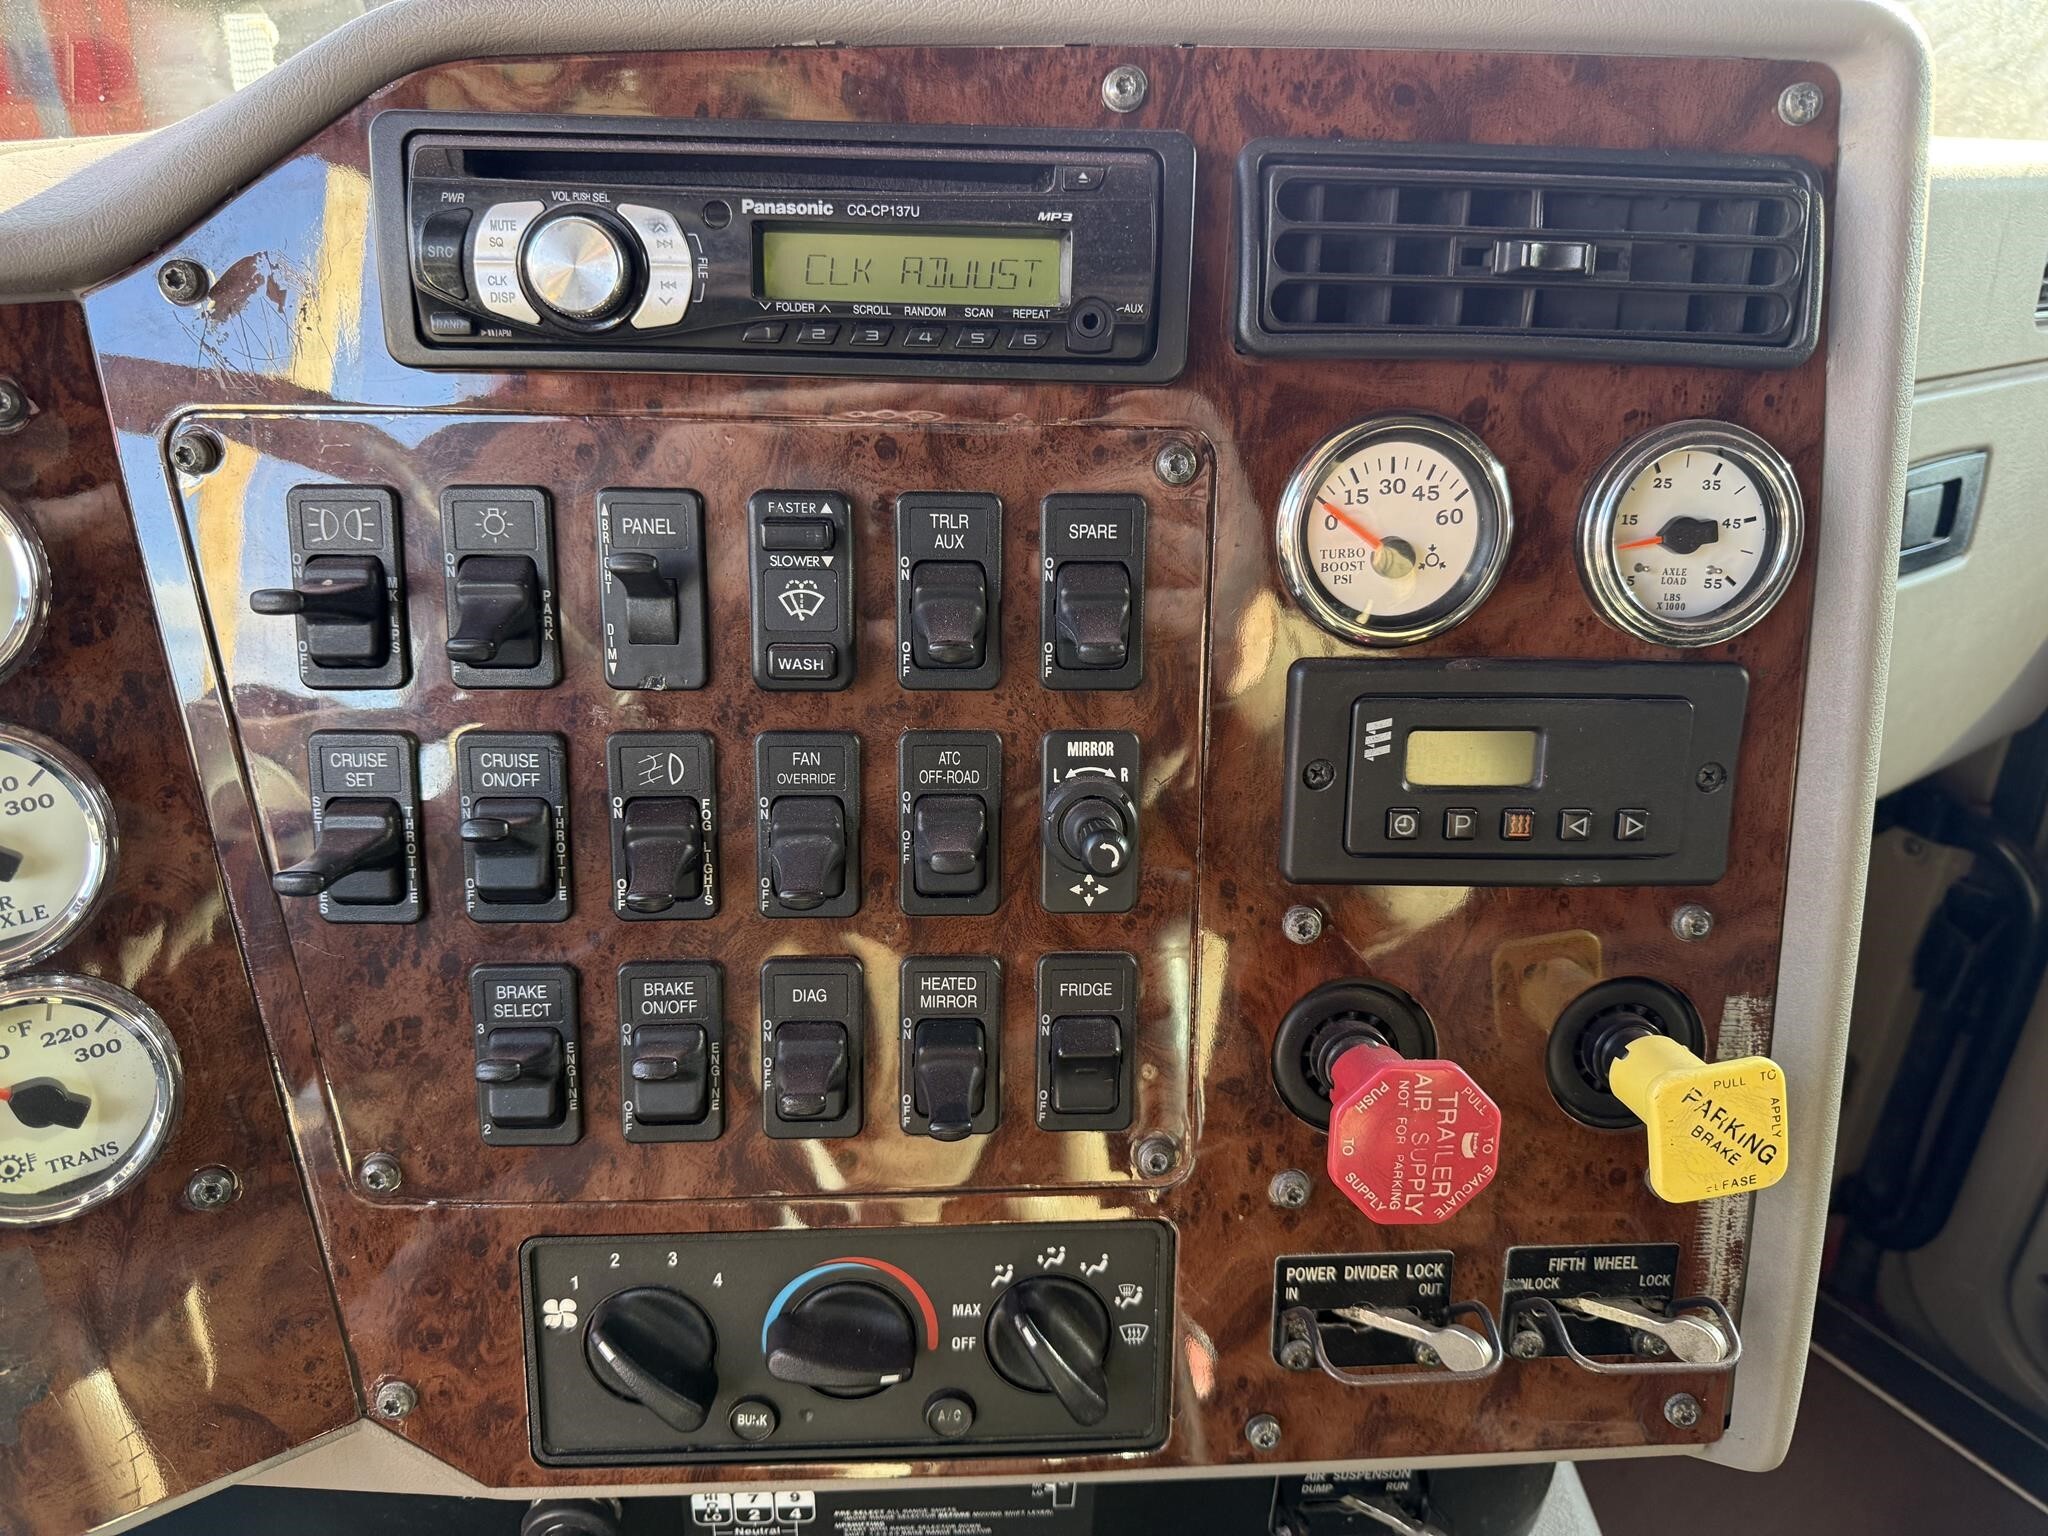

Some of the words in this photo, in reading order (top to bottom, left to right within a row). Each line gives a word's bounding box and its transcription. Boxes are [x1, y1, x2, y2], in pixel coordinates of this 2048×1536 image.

[441, 192, 465, 203] PWR
[552, 191, 570, 201] VOL
[573, 192, 590, 201] PUSH
[593, 192, 610, 202] SEL
[741, 199, 834, 216] Panasonic
[847, 204, 920, 218] CQ-CP137U
[1037, 211, 1073, 222] MP3
[490, 220, 517, 231] MUTE
[489, 237, 503, 248] SQ
[428, 246, 454, 258] SRC
[697, 257, 708, 279] FILE
[806, 254, 871, 285] CLK
[900, 256, 1043, 290] ADJUST
[488, 276, 507, 286] CLK
[491, 292, 515, 303] DISP
[776, 302, 816, 313] FOLDER
[853, 305, 892, 316] SCROLL
[904, 306, 947, 317] RANDOM
[964, 308, 994, 318] SCAN
[1013, 309, 1050, 320] REPEAT
[1124, 303, 1144, 313] AUX
[811, 328, 826, 340] 2
[866, 330, 879, 341] 3
[918, 332, 932, 342] 4
[971, 333, 984, 344] 5
[1023, 334, 1037, 345] 6
[1379, 478, 1406, 495] 30
[1653, 478, 1673, 489] 25
[1702, 480, 1721, 491] 35
[1344, 488, 1369, 505] 15
[1411, 485, 1440, 502] 45
[768, 502, 816, 514] FASTER
[930, 514, 969, 529] TRLR
[1324, 515, 1338, 530] 0
[1436, 508, 1463, 526] 60
[1621, 514, 1638, 525] 15
[1722, 518, 1742, 529] 45
[622, 517, 677, 535] PANEL
[1068, 524, 1118, 539] SPARE
[934, 535, 965, 549] AUX
[769, 555, 820, 567] SLOWER
[1320, 547, 1366, 560] TURBO
[292, 553, 302, 578] ON
[445, 553, 456, 578] ON
[900, 556, 910, 581] ON
[1045, 557, 1054, 582] ON
[1320, 560, 1365, 573] BOOST
[1662, 568, 1687, 576] AXLE
[1333, 574, 1353, 584] PSI
[1661, 577, 1687, 585] LOAD
[1704, 578, 1722, 589] 55
[1664, 593, 1681, 601] LBS
[1656, 602, 1663, 610] X
[1665, 602, 1686, 611] 1000
[543, 590, 555, 641] PARK
[607, 623, 618, 660] DIM
[297, 640, 308, 677] OFF
[778, 658, 824, 671] WASH
[902, 641, 911, 677] OFF
[1044, 642, 1053, 678] OFF
[1067, 741, 1114, 757] MIRROR
[330, 753, 388, 768] CRUISE
[481, 753, 540, 769] CRUISE
[792, 752, 821, 766] FAN
[938, 751, 961, 765] ATC
[345, 773, 375, 787] SET
[481, 773, 540, 788] ON/OFF
[777, 773, 837, 785] OVERRIDE
[919, 770, 980, 784] OFF-ROAD
[1053, 768, 1061, 783] L
[1120, 768, 1129, 782] R
[4, 793, 55, 816] 300
[461, 795, 471, 819] ON
[613, 796, 623, 819] ON
[759, 797, 769, 820] ON
[902, 791, 912, 814] ON
[312, 795, 322, 832] SET
[701, 798, 712, 831] FOG
[1454, 815, 1471, 835] P
[404, 806, 419, 904] THROTTLE
[555, 805, 567, 901] THROTTLE
[902, 830, 911, 864] OFF
[703, 841, 714, 905] LIGHTS
[466, 878, 475, 913] OFF
[617, 878, 627, 910] OFF
[761, 877, 770, 912] OFF
[496, 985, 547, 999] BRAKE
[644, 982, 694, 996] BRAKE
[921, 976, 977, 991] HEATED
[1060, 983, 1112, 996] FRIDGE
[792, 988, 827, 1002] DIAG
[920, 994, 978, 1009] MIRROR
[494, 1003, 552, 1018] SELECT
[641, 999, 698, 1015] ON/OFF
[477, 1023, 485, 1034] 3
[763, 1019, 772, 1042] ON
[903, 1017, 912, 1040] ON
[1041, 1014, 1050, 1036] ON
[40, 1023, 88, 1048] 220
[622, 1023, 632, 1046] ON
[74, 1038, 122, 1062] 300
[566, 1041, 578, 1111] ENGINE
[710, 1042, 720, 1111] ENGINE
[764, 1057, 772, 1091] OFF
[1355, 1080, 1391, 1114] PUSH
[1397, 1080, 1410, 1109] NOT
[1413, 1072, 1433, 1112] AIR
[902, 1094, 911, 1127] OFF
[1039, 1090, 1048, 1122] OFF
[1713, 1077, 1746, 1090] PULL
[1760, 1069, 1777, 1081] TO
[1770, 1097, 1782, 1138] APPLY
[624, 1101, 633, 1134] OFF
[483, 1124, 491, 1135] 2
[1395, 1116, 1408, 1145] FOR
[1681, 1087, 1777, 1166] PARKING
[1342, 1137, 1356, 1156] TO
[1430, 1091, 1460, 1198] TRAILER
[1481, 1136, 1494, 1154] TO
[1690, 1125, 1742, 1166] BRAKE
[45, 1141, 119, 1174] TRANS
[1389, 1154, 1405, 1210] PARKING
[1404, 1132, 1430, 1216] SUPPLY
[1344, 1171, 1388, 1212] SUPPLY
[1432, 1164, 1494, 1220] EVACUATE
[570, 1275, 579, 1291] 1
[610, 1253, 620, 1268] 2
[667, 1252, 678, 1268] 3
[712, 1272, 724, 1287] 4
[1286, 1266, 1336, 1282] POWER
[1344, 1264, 1398, 1280] DIVIDER
[1407, 1262, 1445, 1278] LOCK
[1549, 1258, 1585, 1271] FIFTH
[1594, 1256, 1638, 1270] WHEEL
[1640, 1274, 1671, 1287] LOCK
[1285, 1287, 1298, 1300] IN
[1418, 1283, 1443, 1296] OUT
[952, 1303, 981, 1317] MAX
[951, 1336, 976, 1350] OFF
[938, 1408, 961, 1422] A/C
[1305, 1472, 1326, 1482] AIR
[1333, 1469, 1412, 1481] SUSPENSION
[1302, 1483, 1334, 1494] DUMP
[1386, 1481, 1408, 1491] RUN
[748, 1509, 760, 1520] 2
[790, 1508, 801, 1519] 4
[735, 1526, 781, 1536] Neutral
